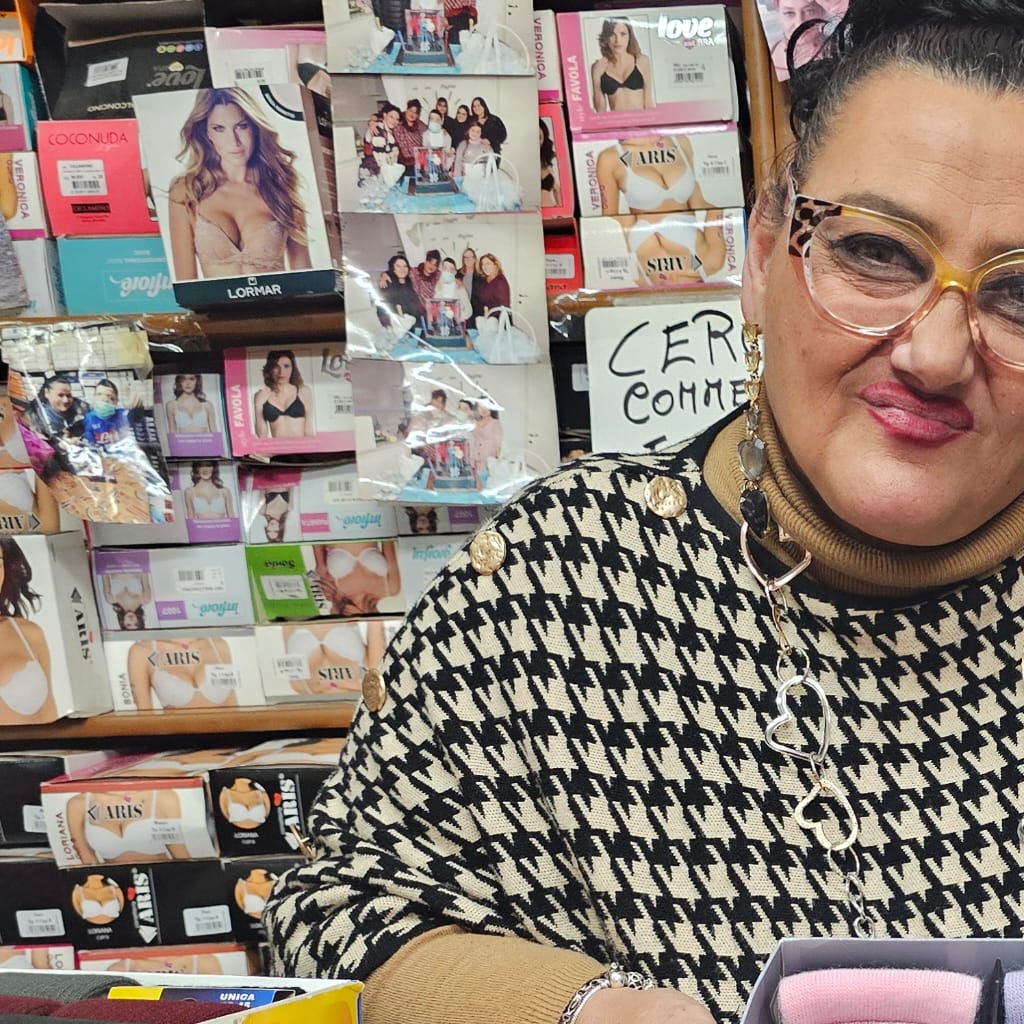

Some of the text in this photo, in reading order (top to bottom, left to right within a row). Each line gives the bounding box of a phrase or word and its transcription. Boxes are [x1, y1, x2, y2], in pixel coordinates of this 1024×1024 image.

[533, 17, 547, 81] VERONICA
[566, 55, 582, 102] FAVOLA
[48, 132, 128, 146] COCONUDA
[636, 151, 676, 166] ARIS
[14, 159, 30, 219] VERONICA
[585, 151, 601, 211] VERONICA
[227, 284, 282, 300] LORMAR
[233, 384, 243, 428] FAVOLA
[163, 651, 201, 666] ARIS
[104, 803, 143, 820] ARIS
[55, 811, 76, 861] LORIANA
[219, 993, 256, 1002] UNICA
